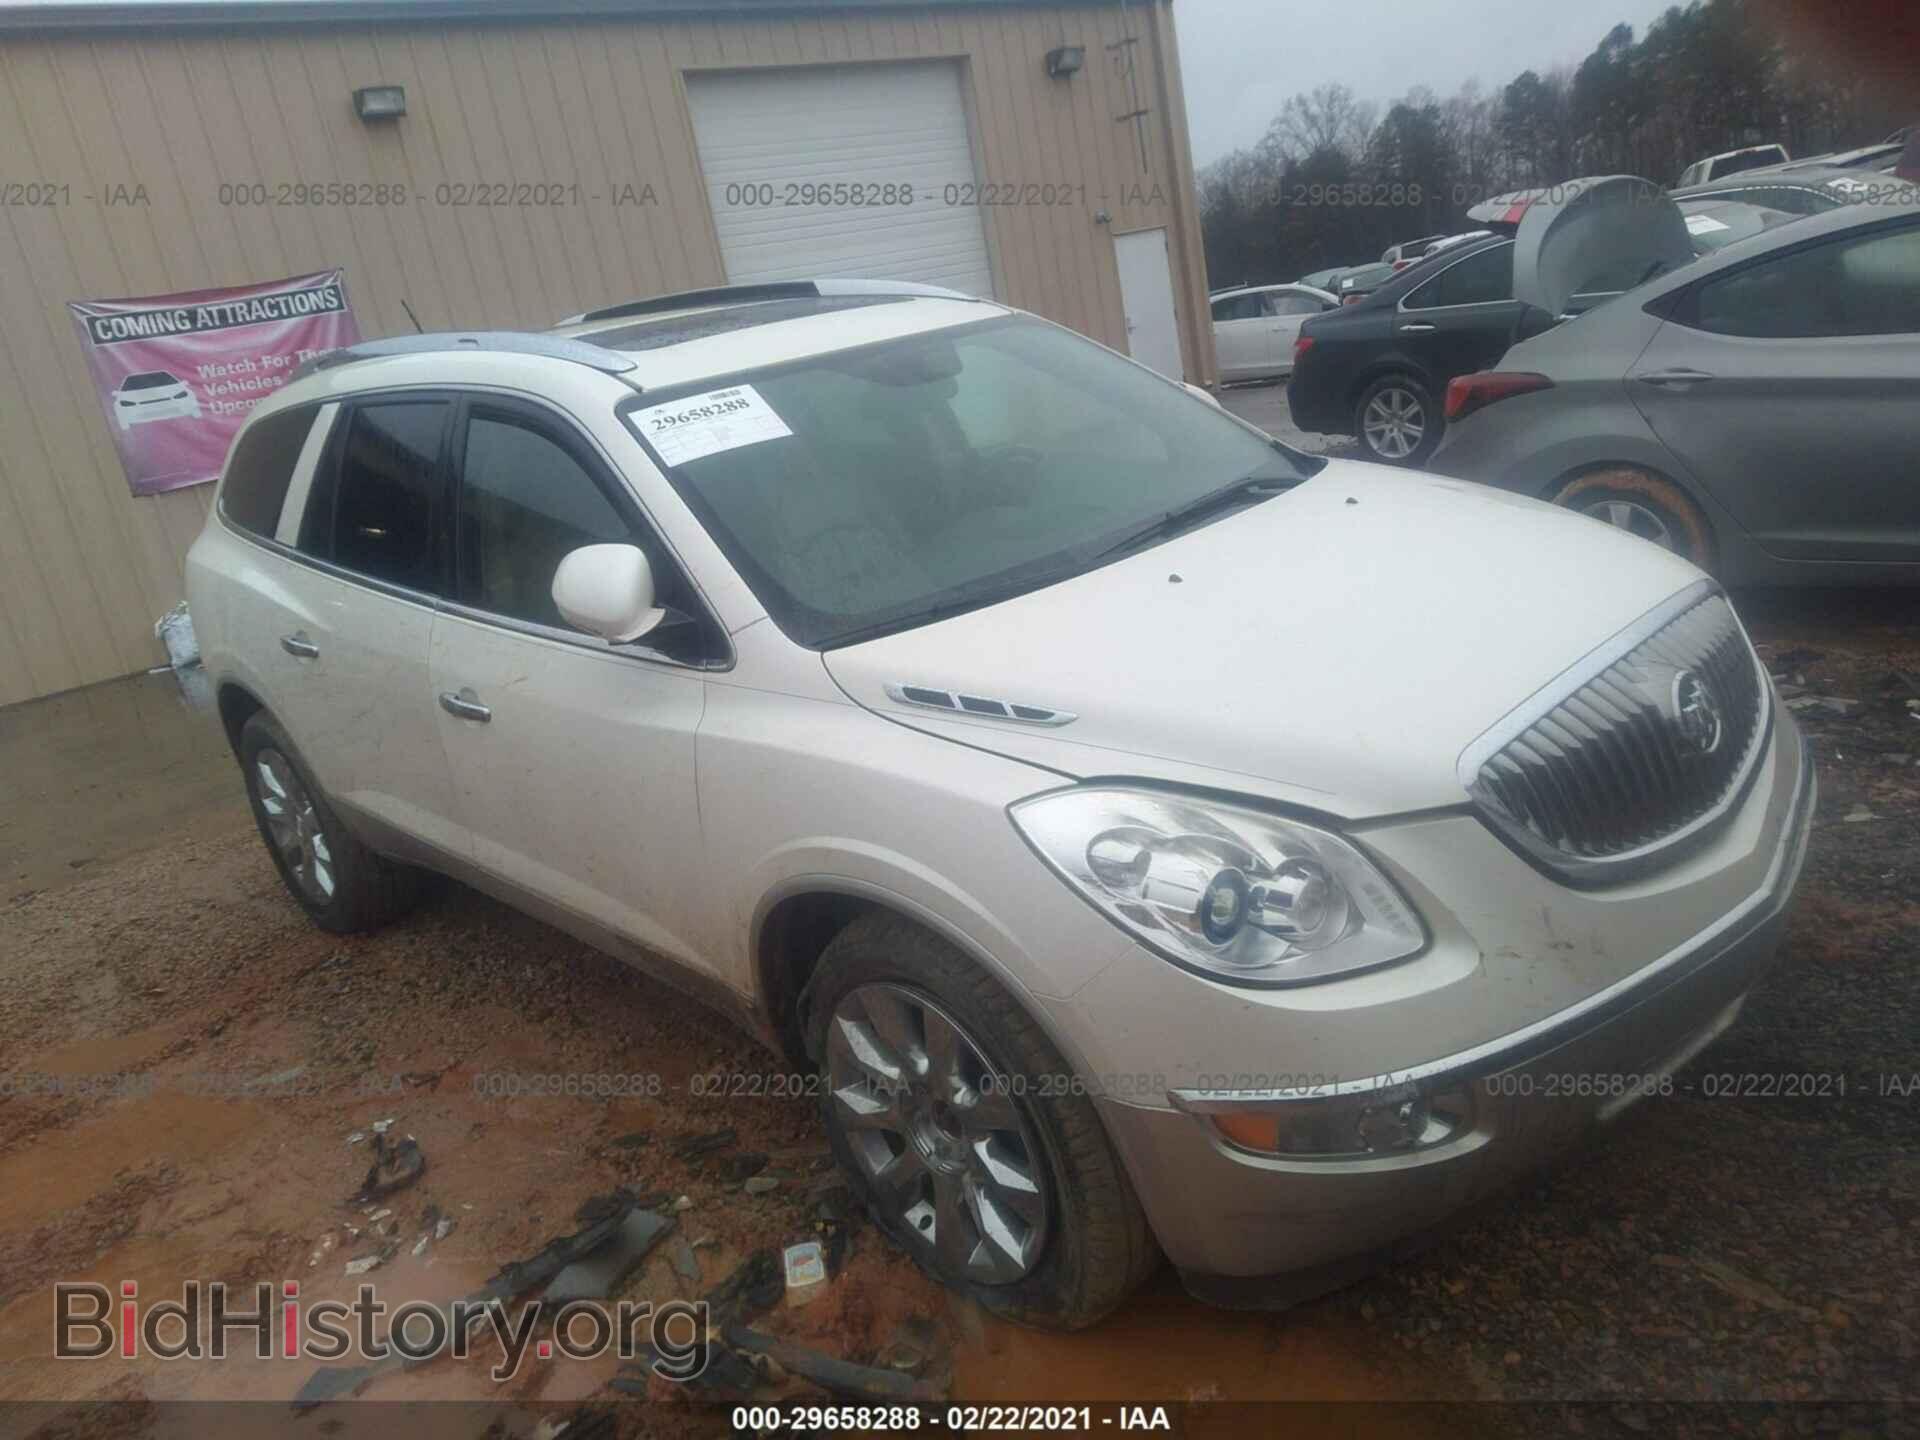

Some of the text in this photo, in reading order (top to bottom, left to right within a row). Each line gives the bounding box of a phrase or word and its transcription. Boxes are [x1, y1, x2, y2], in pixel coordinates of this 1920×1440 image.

[94, 288, 339, 341] COMING ATTRACTIONS
[196, 359, 257, 379] Watch
[260, 354, 291, 369] For
[203, 375, 283, 396] Vehicles
[651, 398, 750, 431] 29658288
